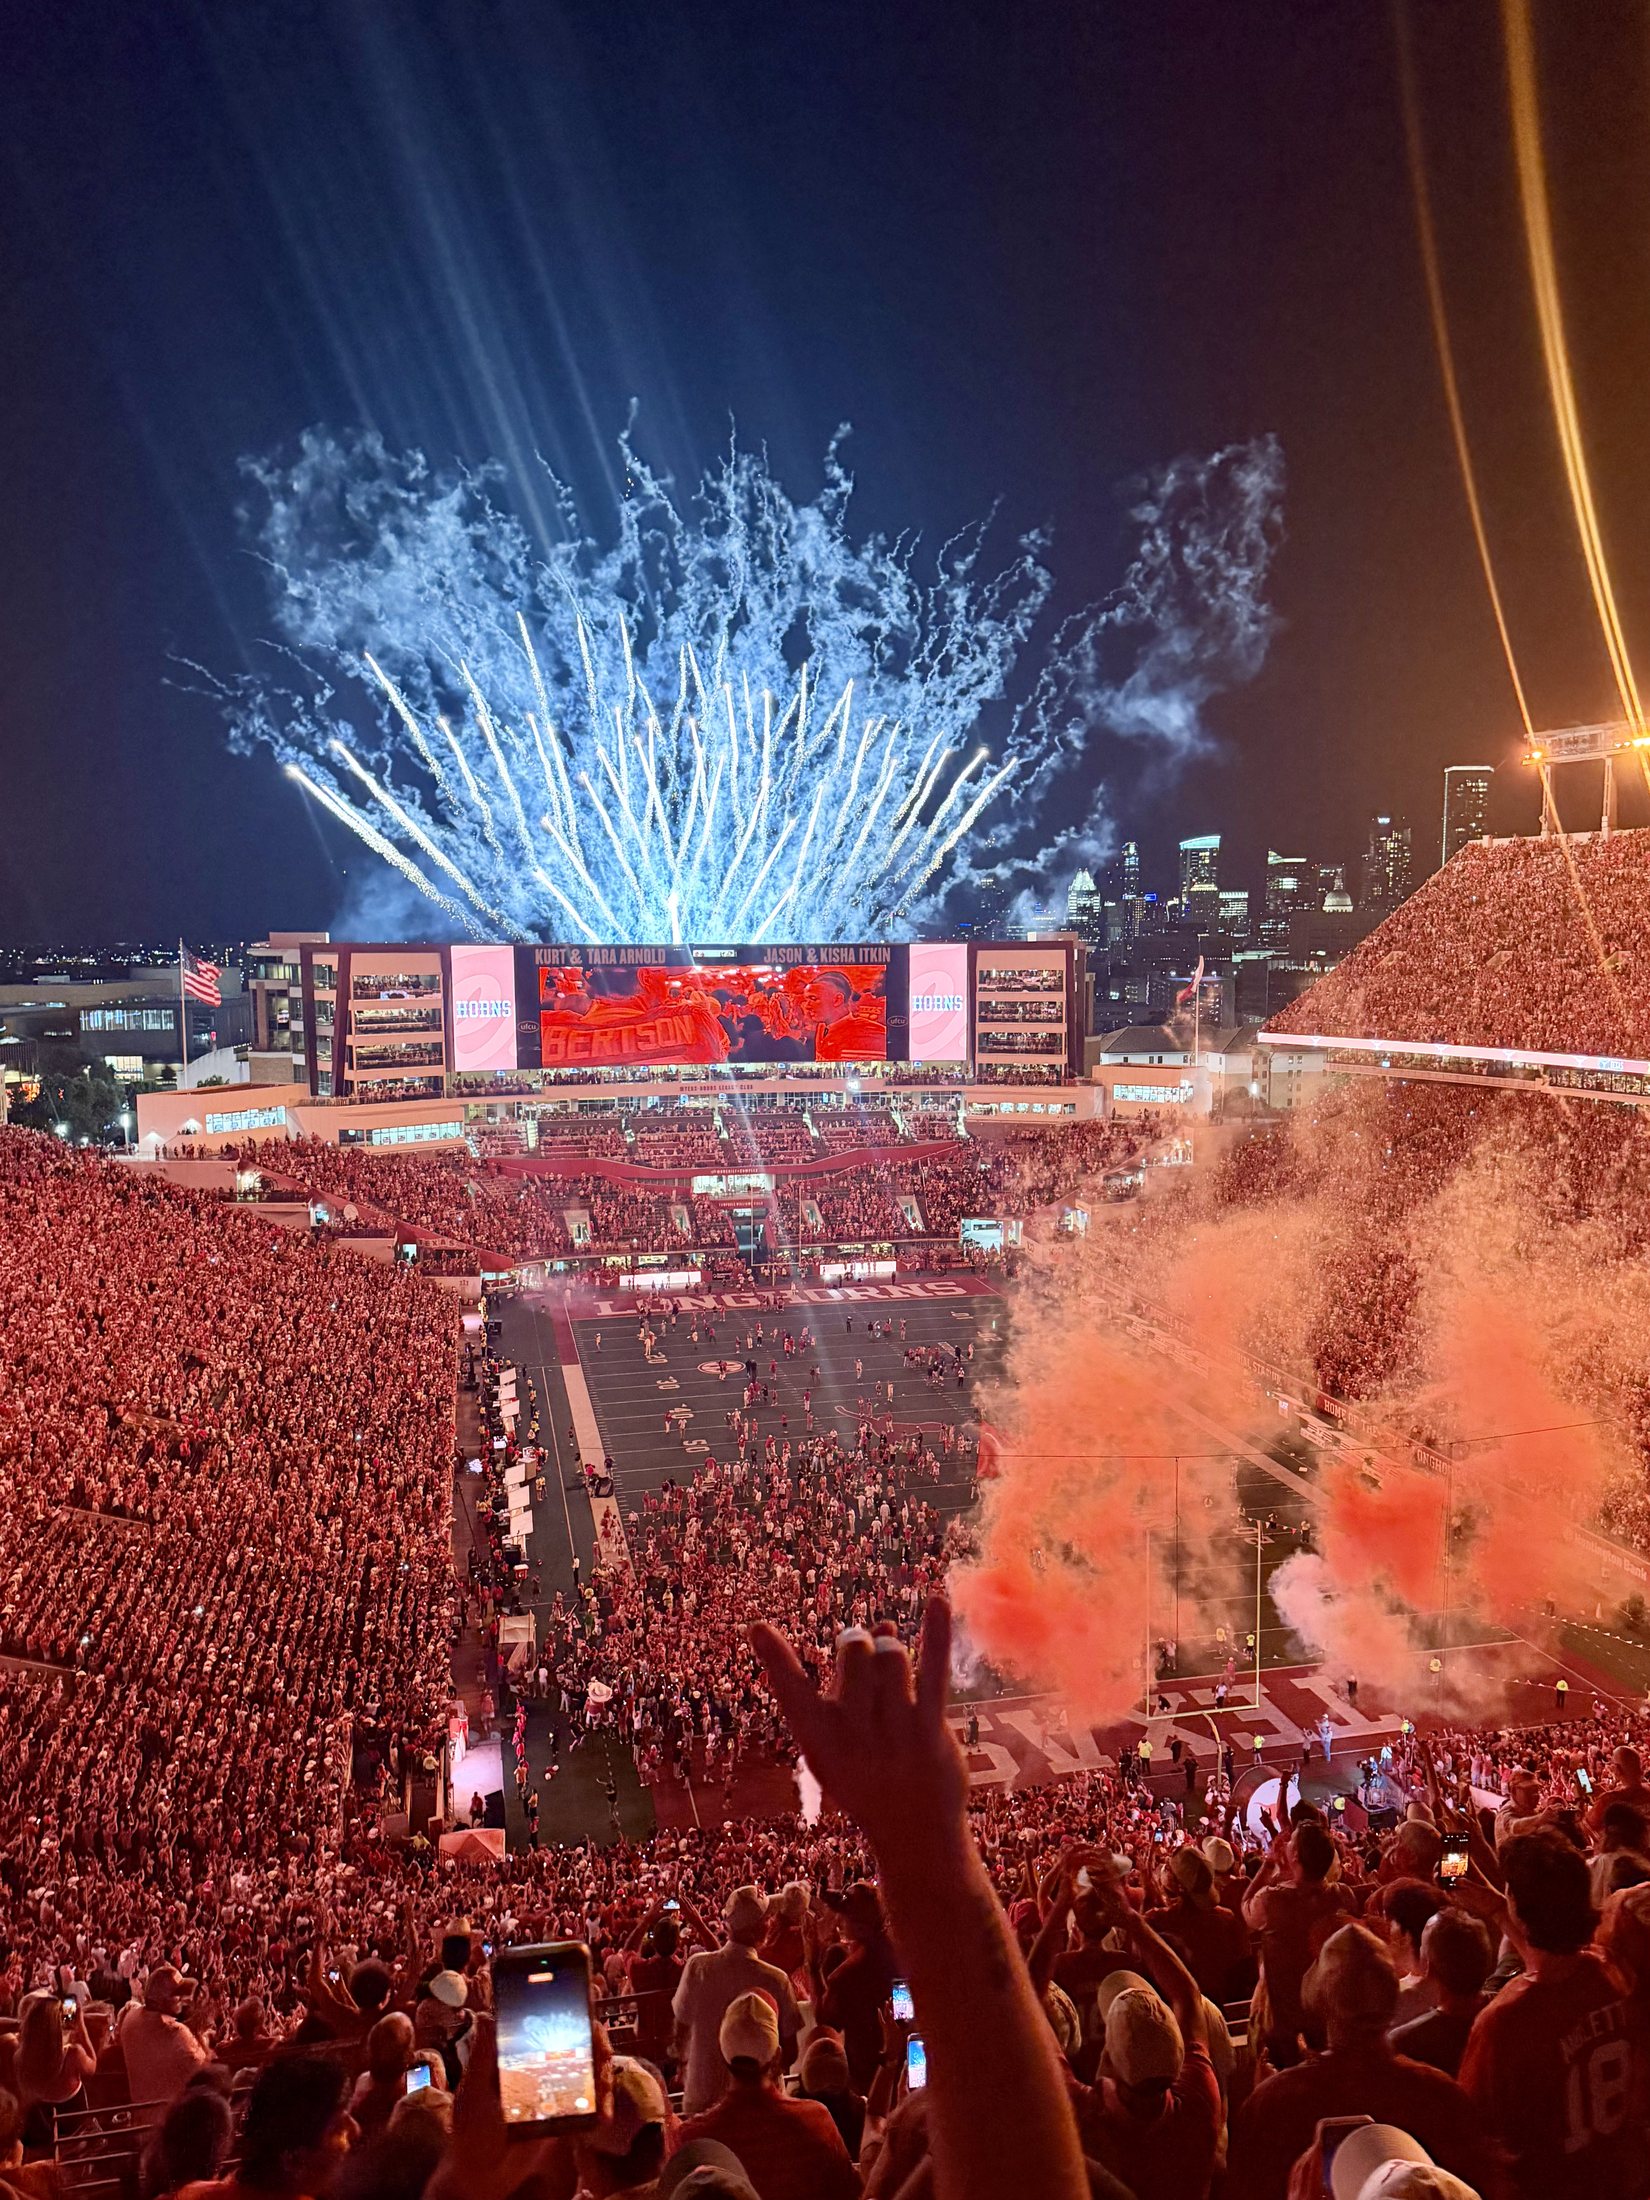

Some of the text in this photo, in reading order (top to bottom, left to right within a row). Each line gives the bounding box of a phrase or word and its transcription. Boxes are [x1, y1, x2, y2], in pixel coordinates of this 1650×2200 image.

[535, 948, 666, 965] KURT & TARA ARNOLD
[763, 947, 891, 964] JASON & KISHA ITKIN
[455, 1000, 513, 1019] HORNS
[911, 994, 963, 1012] HORNS
[519, 1022, 539, 1031] ufcu
[888, 1016, 906, 1026] ufcu
[541, 1014, 695, 1062] BERTSON
[419, 1238, 456, 1247] TEXAS
[593, 1281, 968, 1316] LONGHORNS
[656, 1377, 680, 1390] 30
[1324, 1399, 1379, 1438] HOME OF THE
[682, 1439, 711, 1453] 50
[1623, 1557, 1648, 1581] Bank
[944, 1675, 1409, 1785] TEXAS
[1564, 2039, 1631, 2153] 18
